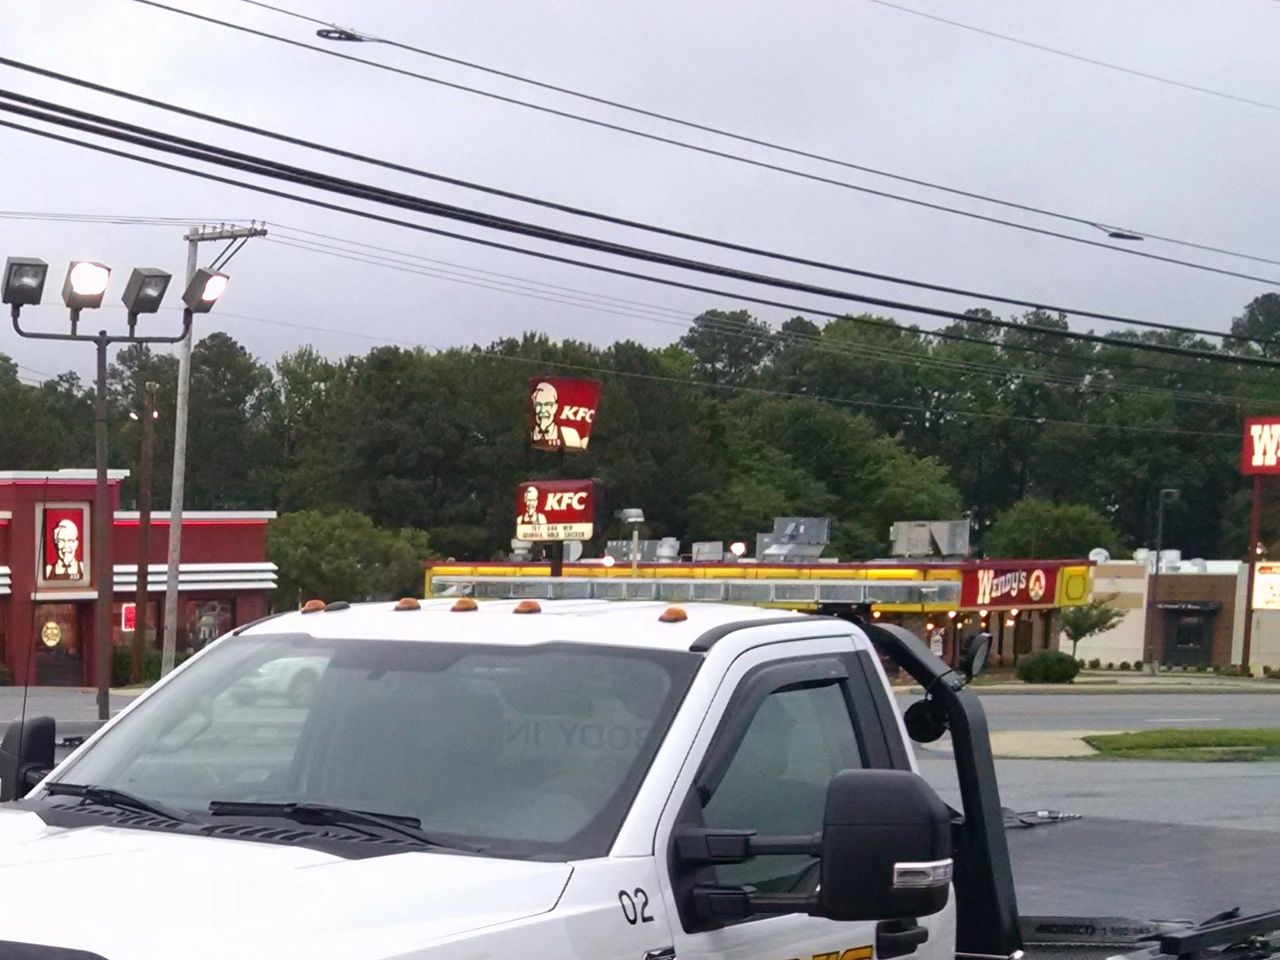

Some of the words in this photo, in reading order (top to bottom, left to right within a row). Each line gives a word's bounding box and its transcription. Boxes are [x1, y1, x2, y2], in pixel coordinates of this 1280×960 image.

[560, 406, 595, 423] KFC
[544, 492, 588, 511] KFC
[618, 887, 655, 926] 02
